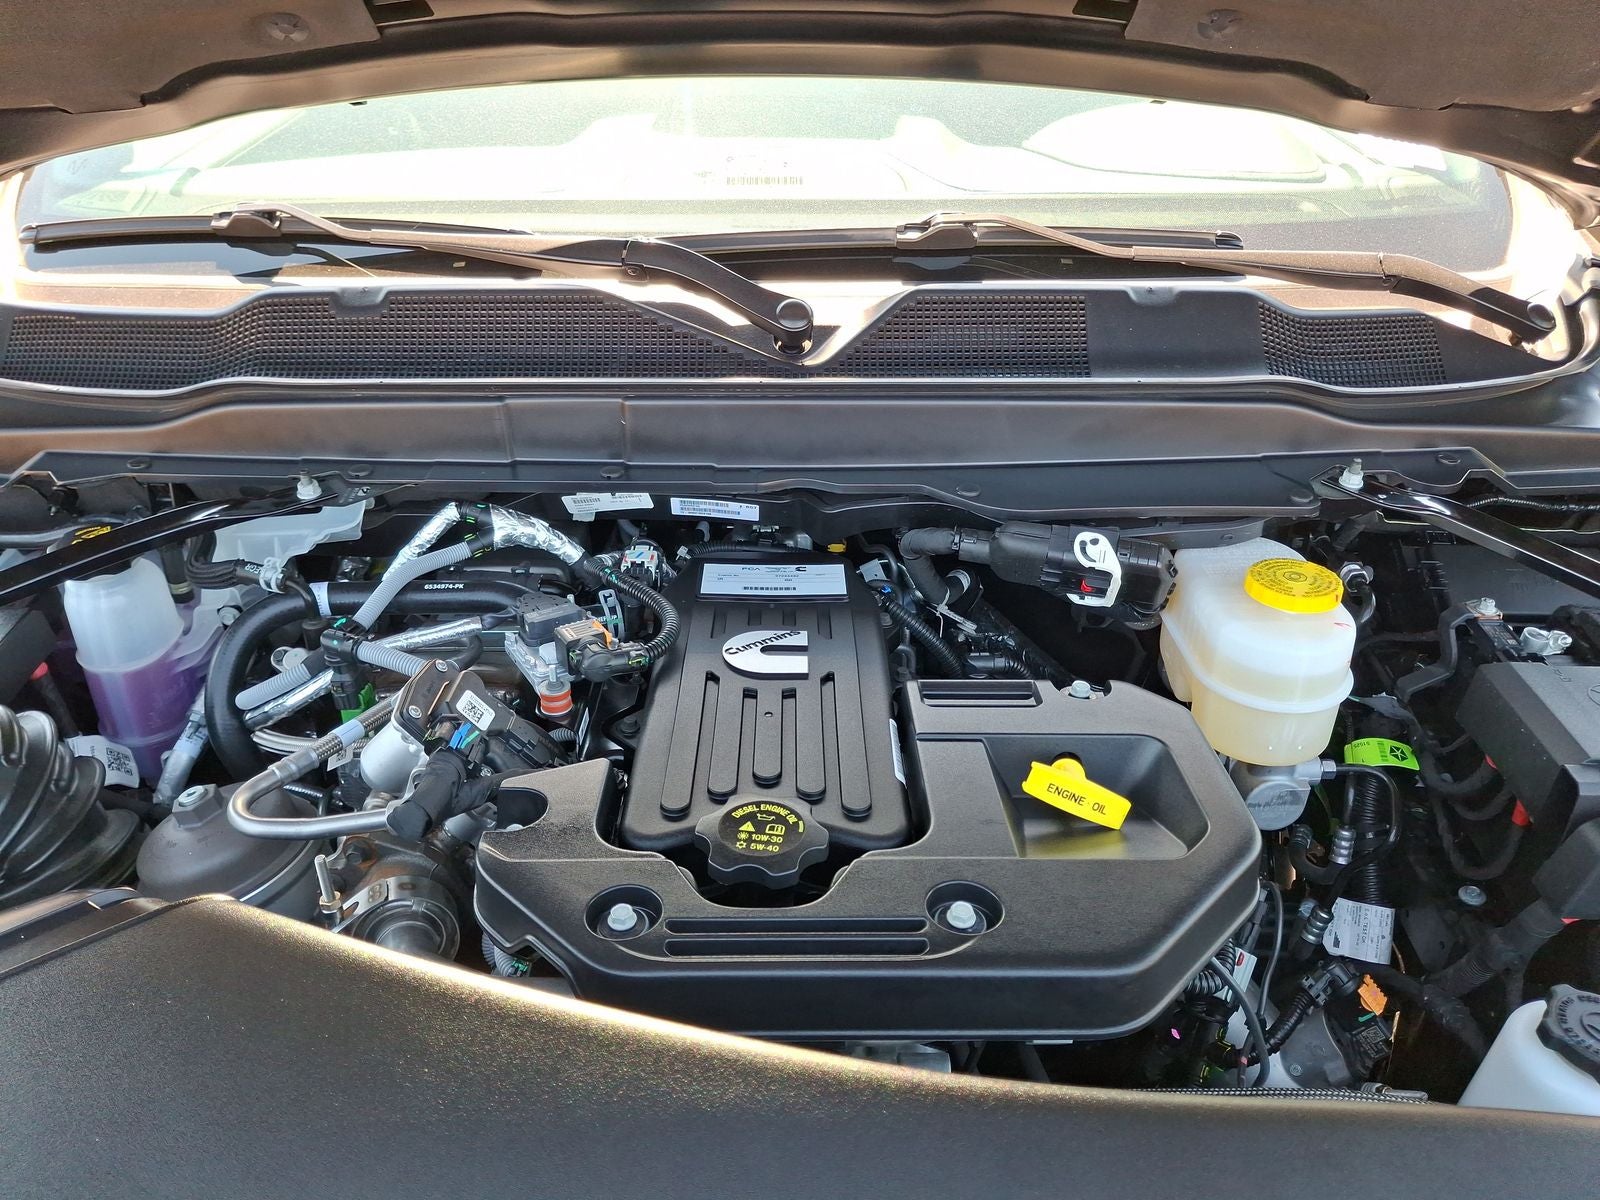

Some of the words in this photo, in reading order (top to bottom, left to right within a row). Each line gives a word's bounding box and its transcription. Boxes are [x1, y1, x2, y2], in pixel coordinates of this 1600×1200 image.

[724, 630, 801, 655] Cummins
[1046, 783, 1087, 806] ENGINE
[1091, 802, 1107, 815] OIL
[731, 804, 760, 819] DIESEL
[760, 804, 788, 817] ENGINE
[786, 811, 798, 825] OIL
[749, 843, 780, 852] 5W-40
[751, 833, 783, 843] 10W-30
